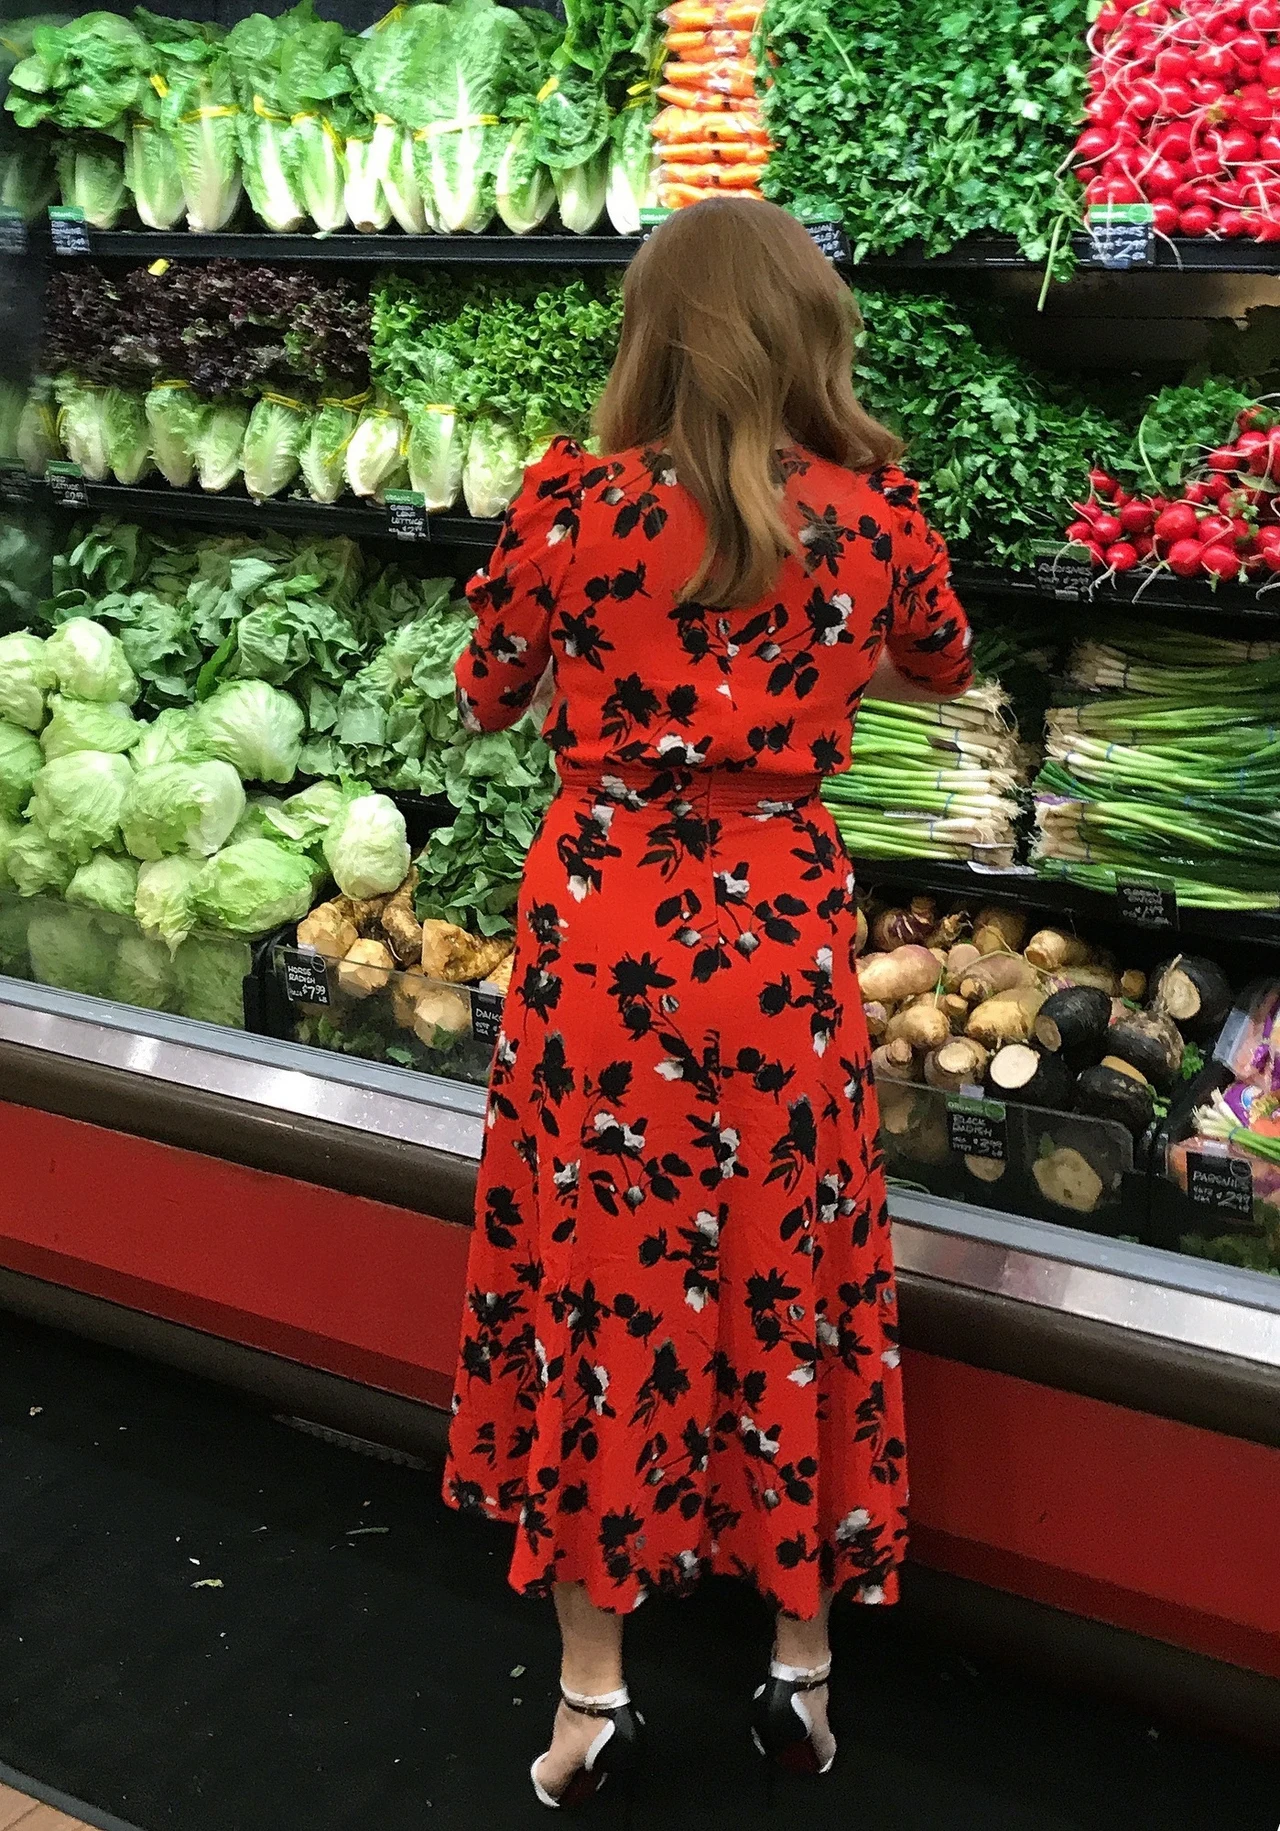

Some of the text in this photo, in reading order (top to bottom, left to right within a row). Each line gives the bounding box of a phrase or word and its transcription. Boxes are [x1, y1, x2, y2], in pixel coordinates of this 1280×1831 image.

[391, 517, 424, 526] LETTUCE
[288, 966, 312, 976] HORSE
[289, 973, 316, 984] RADISH
[953, 1114, 986, 1126] BLACK
